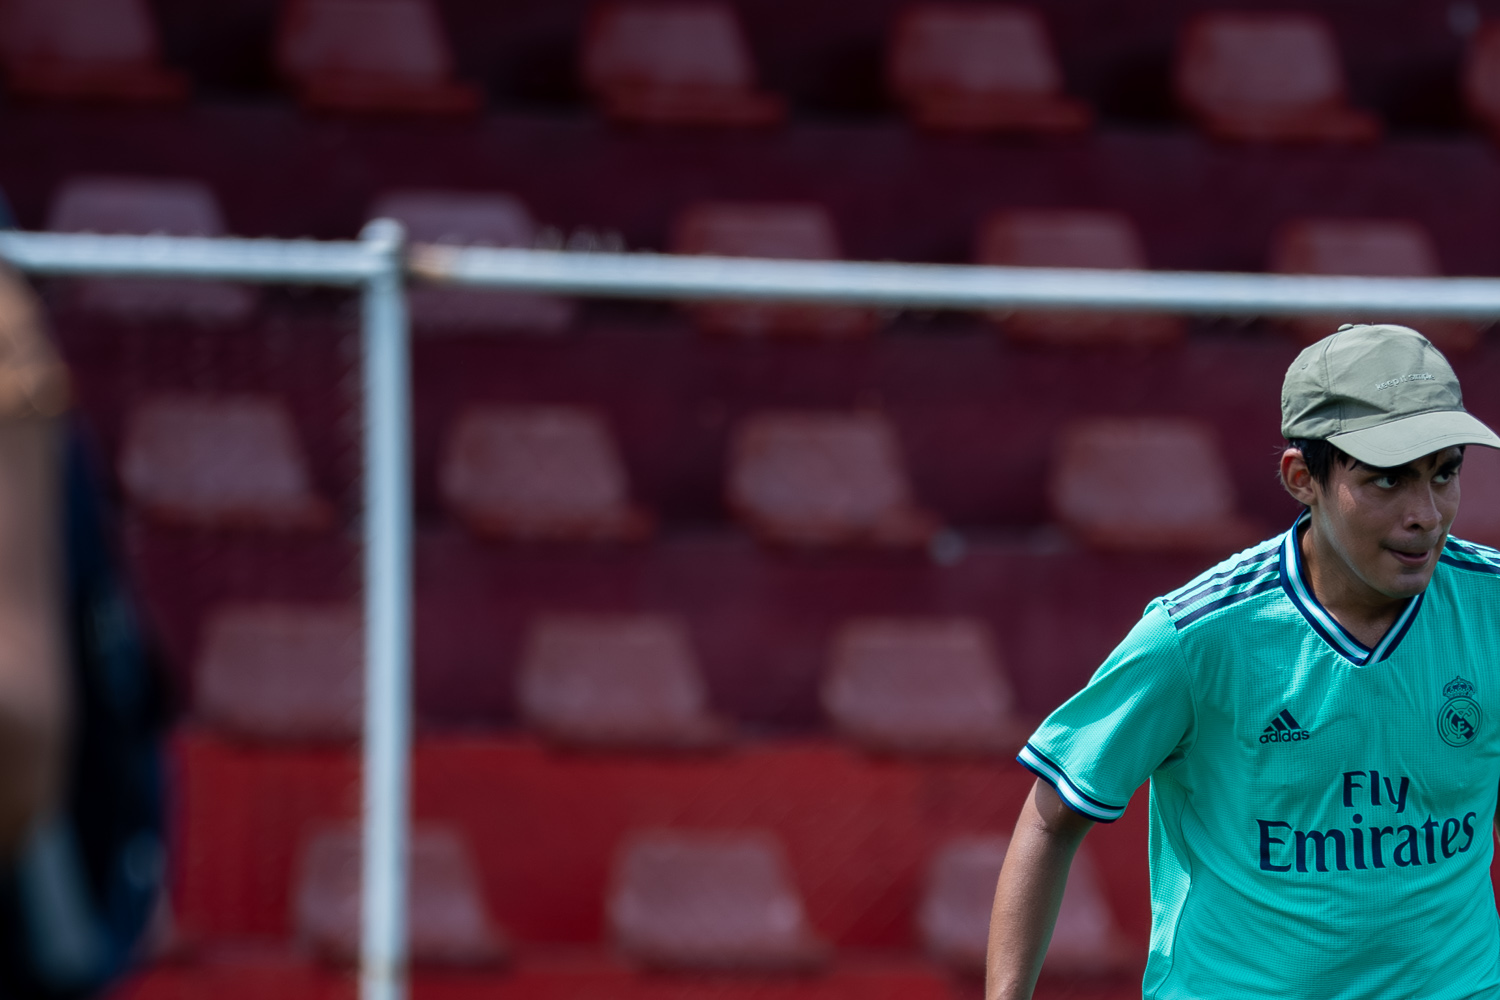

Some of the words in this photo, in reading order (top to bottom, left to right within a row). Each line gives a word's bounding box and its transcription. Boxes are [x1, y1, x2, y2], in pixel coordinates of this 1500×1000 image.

[1259, 728, 1310, 744] adidas
[1342, 770, 1410, 813] Fly
[1256, 811, 1477, 873] Emirates
